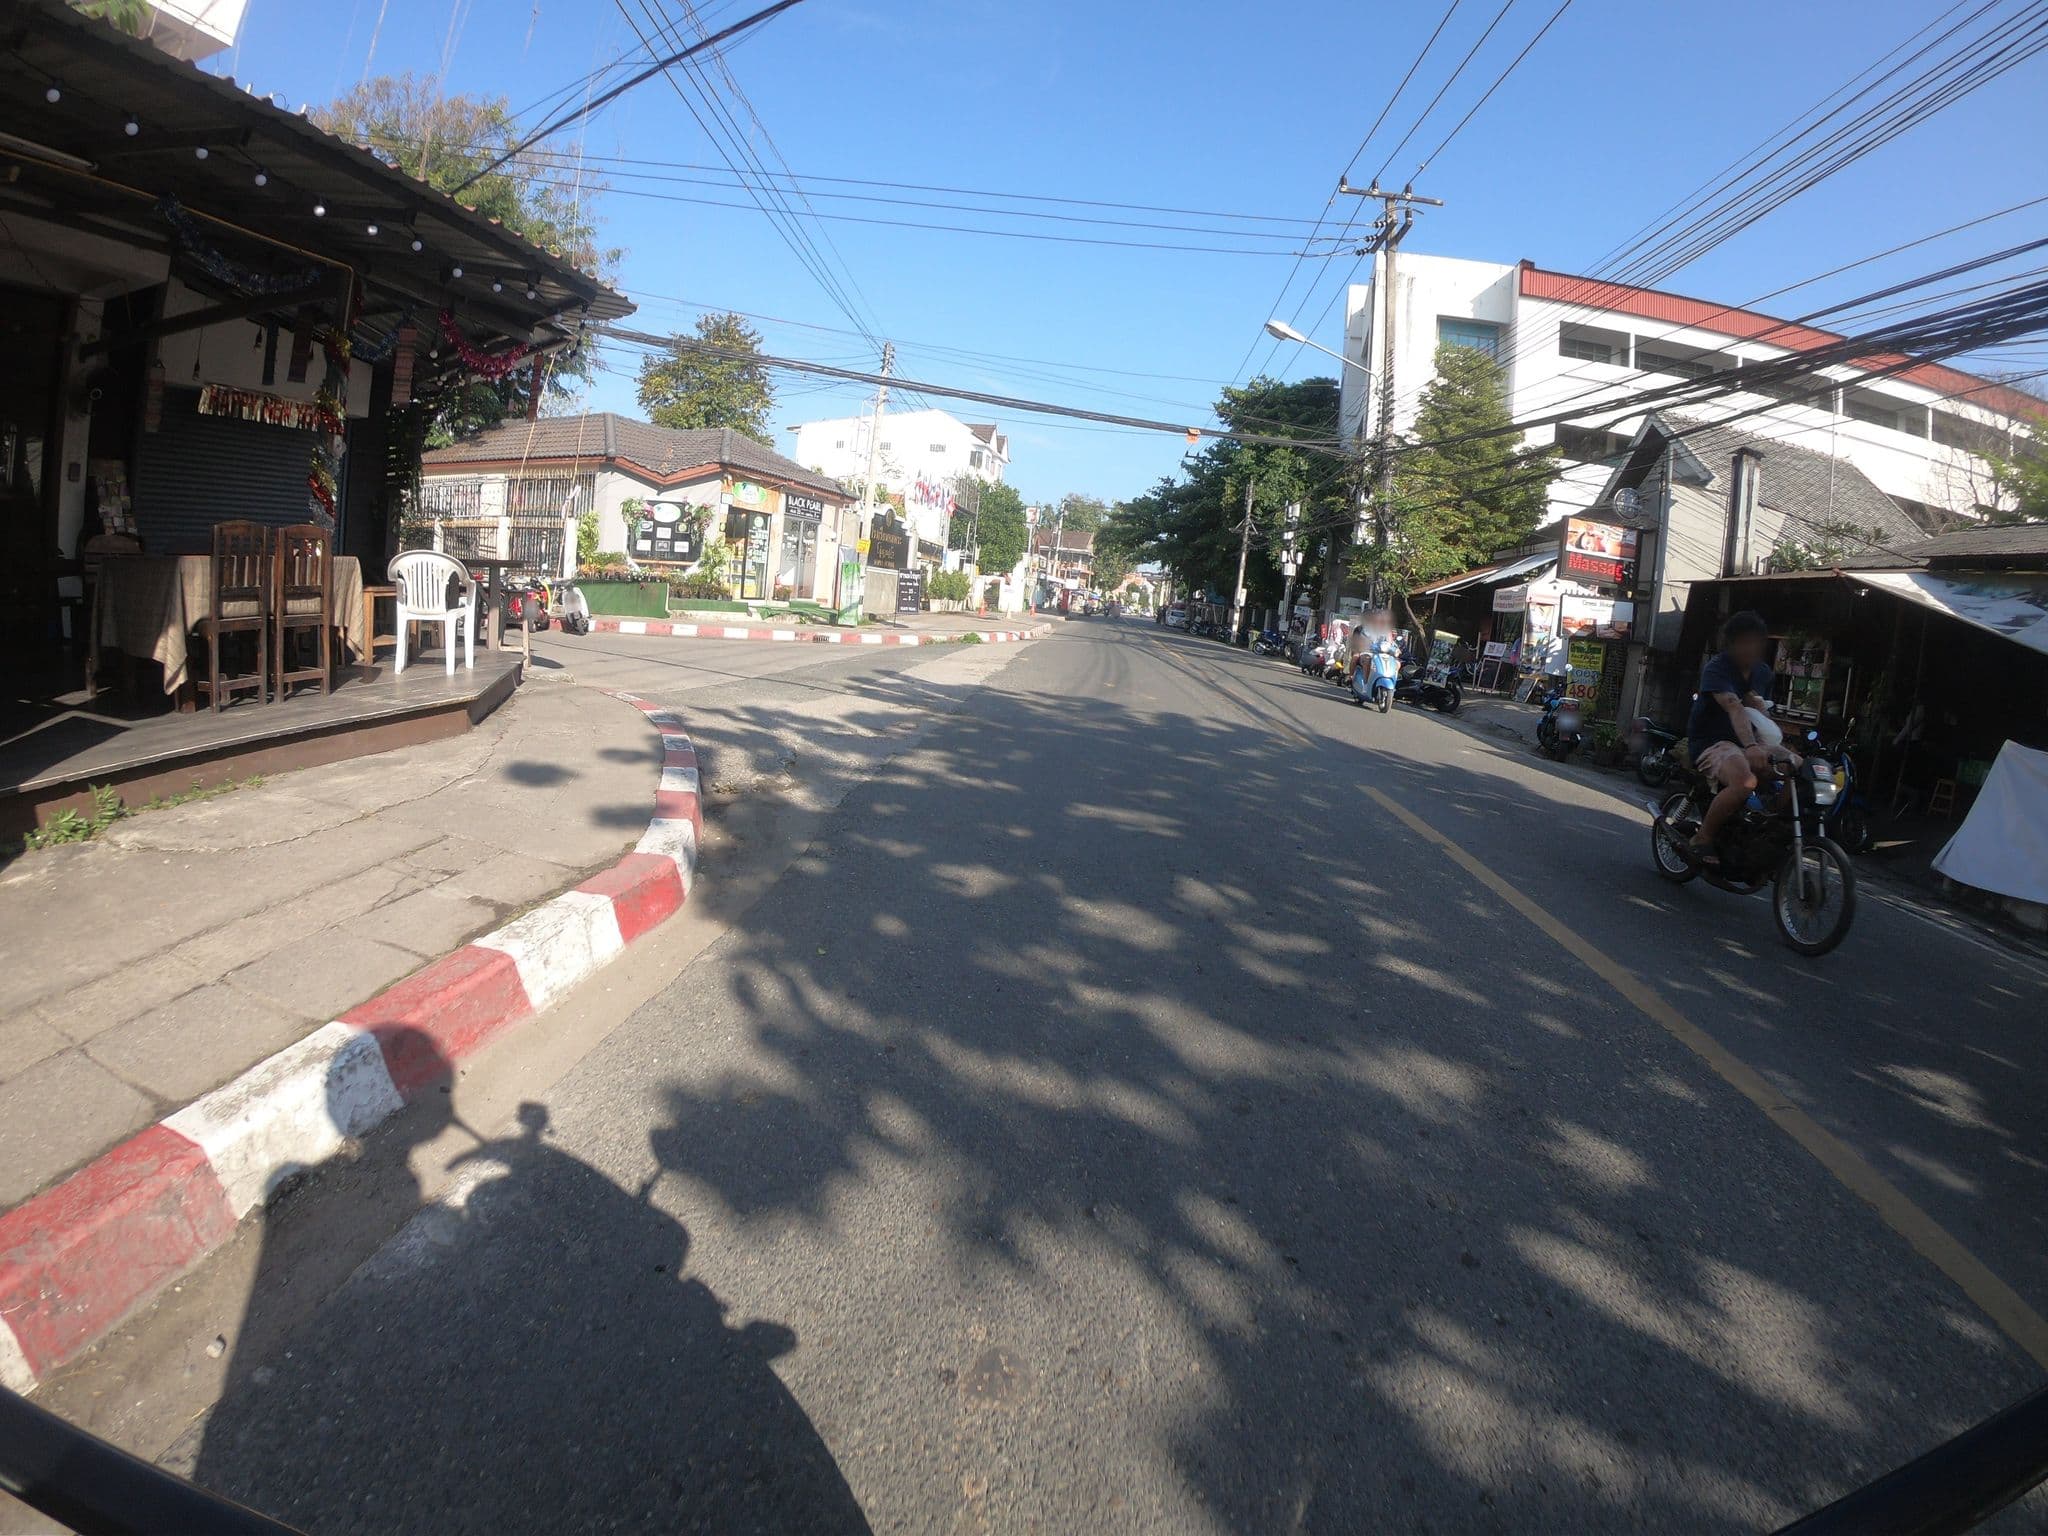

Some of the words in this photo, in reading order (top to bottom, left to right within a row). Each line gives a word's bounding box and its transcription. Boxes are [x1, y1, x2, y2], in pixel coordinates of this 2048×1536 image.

[208, 384, 259, 420] HAPPY
[262, 396, 293, 426] NEW
[1568, 684, 1597, 699] 480
